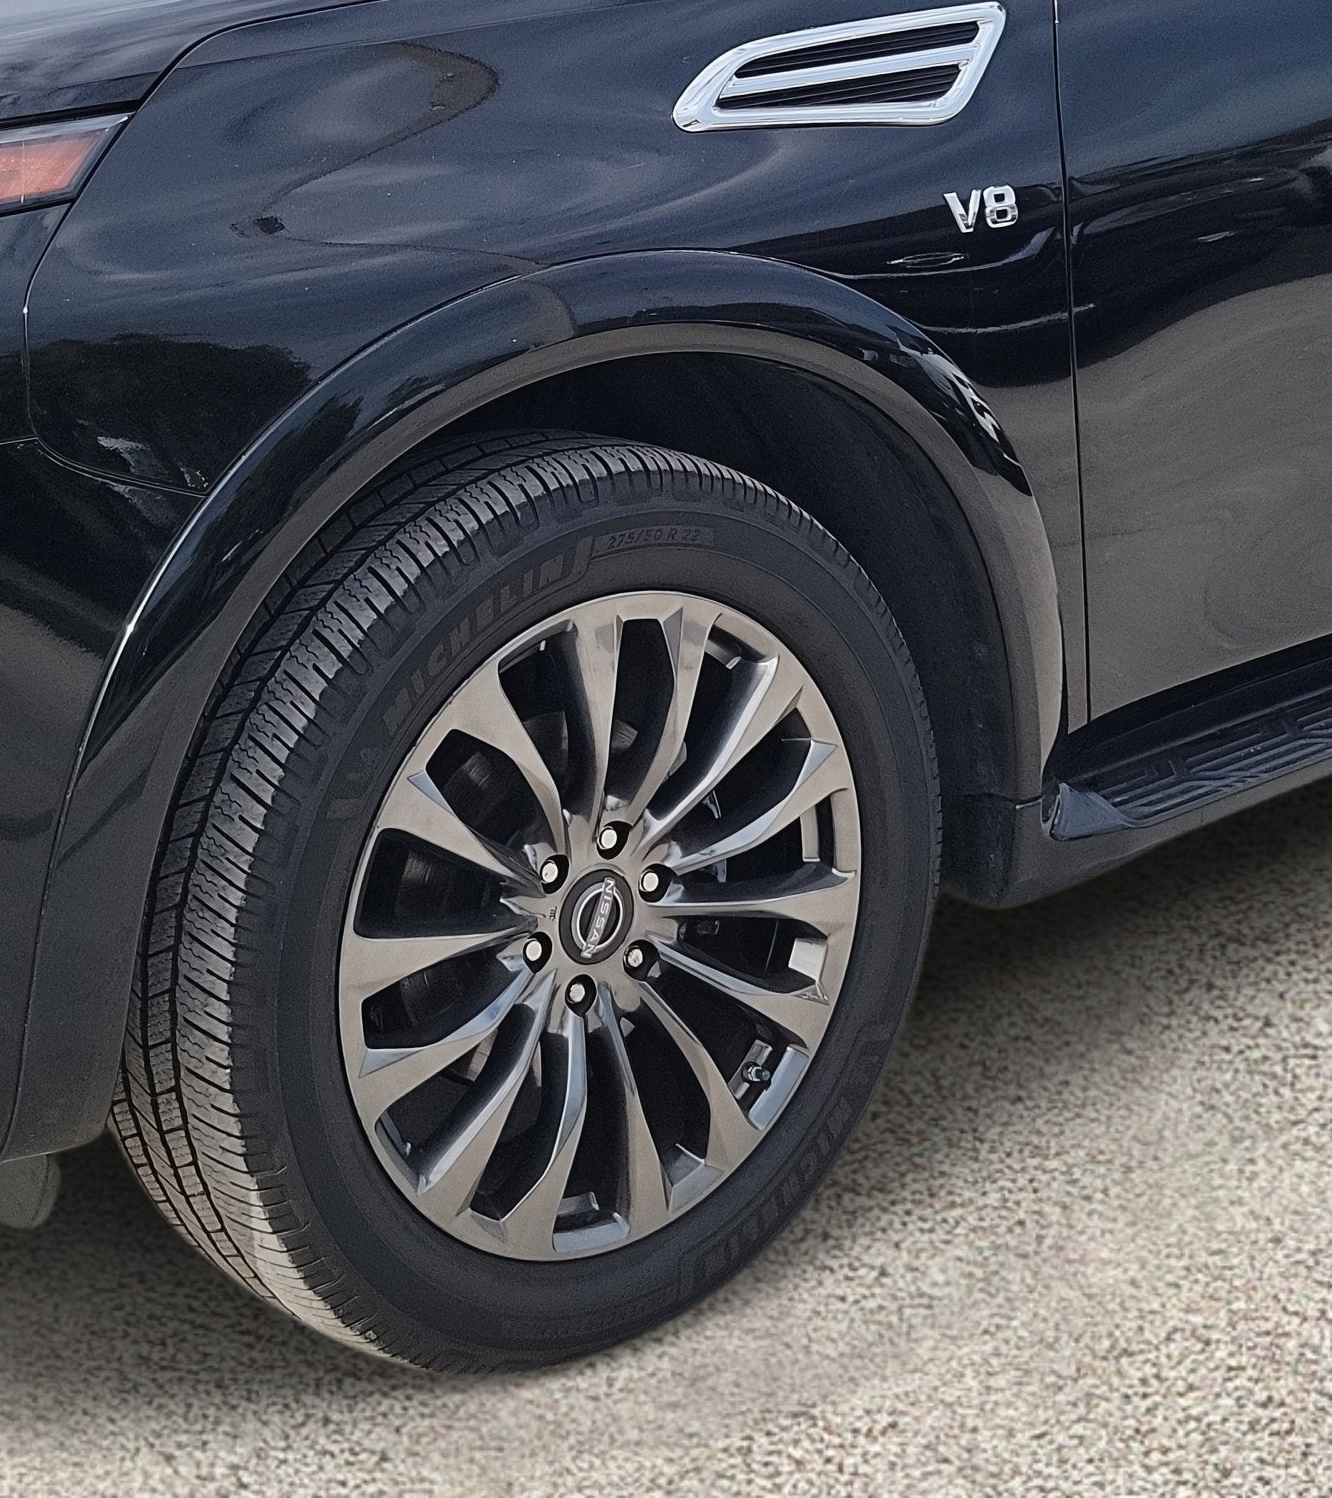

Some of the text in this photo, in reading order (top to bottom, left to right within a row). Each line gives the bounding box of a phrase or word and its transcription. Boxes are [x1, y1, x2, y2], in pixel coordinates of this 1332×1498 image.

[942, 184, 1019, 234] V8
[382, 554, 566, 737] MICHELIN
[582, 879, 615, 958] NISSAN
